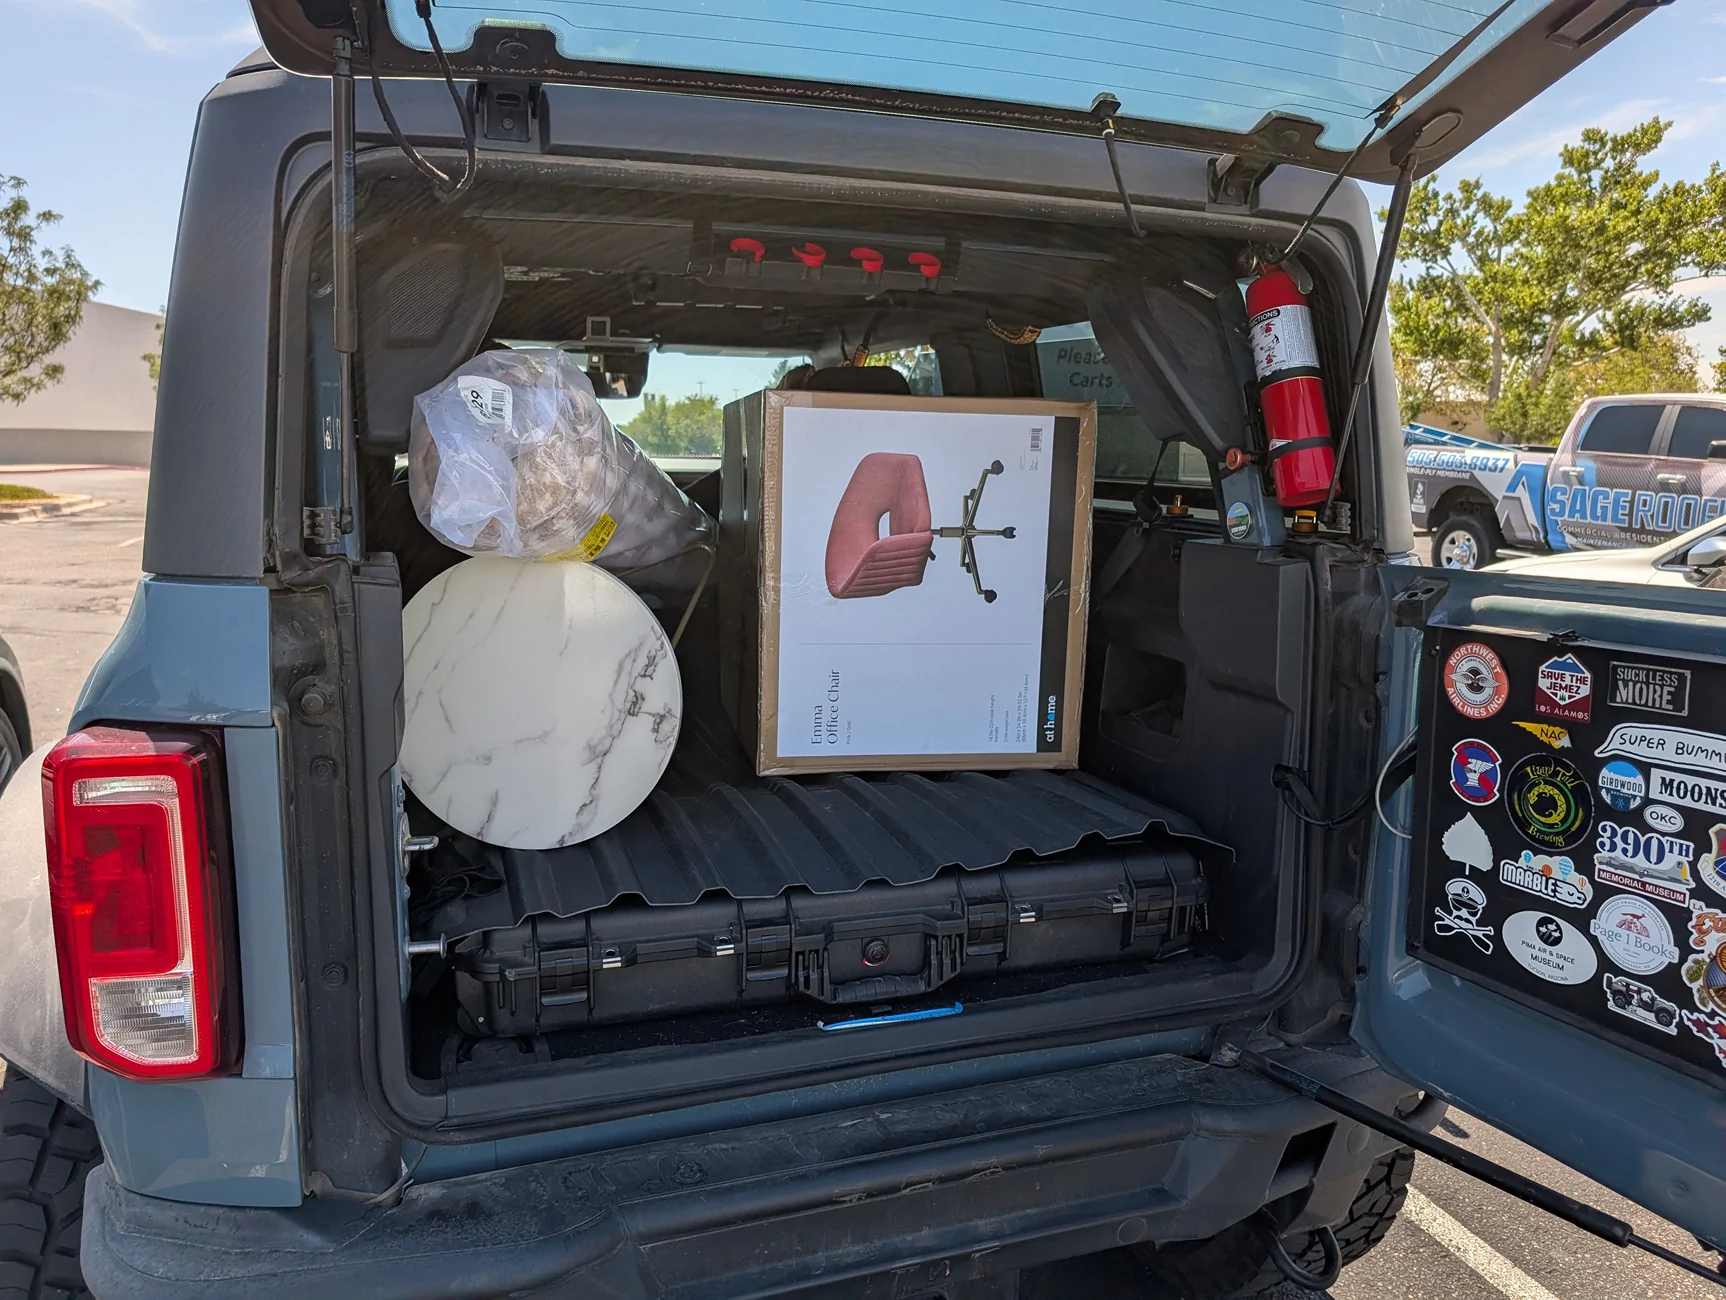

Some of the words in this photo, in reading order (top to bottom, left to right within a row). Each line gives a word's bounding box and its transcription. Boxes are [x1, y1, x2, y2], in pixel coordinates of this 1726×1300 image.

[1069, 371, 1113, 388] Carts
[1407, 451, 1510, 473] 505.503.8937
[1437, 470, 1471, 479] MEMBRANE
[1549, 484, 1631, 527] SAGE
[1557, 524, 1612, 538] COMMERCIAL
[1449, 645, 1501, 674] NORTHWEST
[827, 669, 840, 702] Chair
[1540, 669, 1566, 682] SAVE
[1569, 674, 1589, 686] THE
[1616, 667, 1647, 682] SUCK
[1649, 671, 1678, 686] LESS
[1546, 682, 1581, 695] JEMEZ
[1616, 681, 1675, 710] MORE
[1447, 687, 1487, 717] AIRLINES
[1487, 694, 1505, 713] INC.
[1535, 704, 1551, 713] LOS
[1553, 707, 1589, 720] ALAMOS
[811, 705, 823, 744] Emma
[826, 705, 839, 744] Office
[1045, 730, 1055, 742] at
[1619, 733, 1666, 751] SUPER
[1675, 742, 1726, 763] BUMM
[1524, 758, 1555, 779] Lizard
[1556, 767, 1584, 789] Tail
[1601, 775, 1643, 794] GIRDWOOD
[1649, 811, 1677, 826] OKC
[1528, 826, 1566, 846] Brewing
[1598, 824, 1691, 866] 390TH
[1503, 863, 1556, 897] MARBLE
[1600, 870, 1644, 890] MEMORIAL
[1645, 884, 1685, 902] MUSEUM
[1707, 872, 1720, 887] 12TH
[1692, 903, 1704, 911] LA
[1593, 922, 1622, 942] Page
[1625, 933, 1631, 945] 1
[1634, 935, 1676, 960] Books
[1521, 940, 1536, 951] PIMA
[1537, 945, 1547, 955] AIR
[1548, 949, 1554, 957] &
[1555, 952, 1575, 965] SPACE
[1530, 953, 1565, 971] MUSEUM
[1527, 963, 1547, 979] TUCSON,
[1547, 974, 1569, 982] ARIZONA
